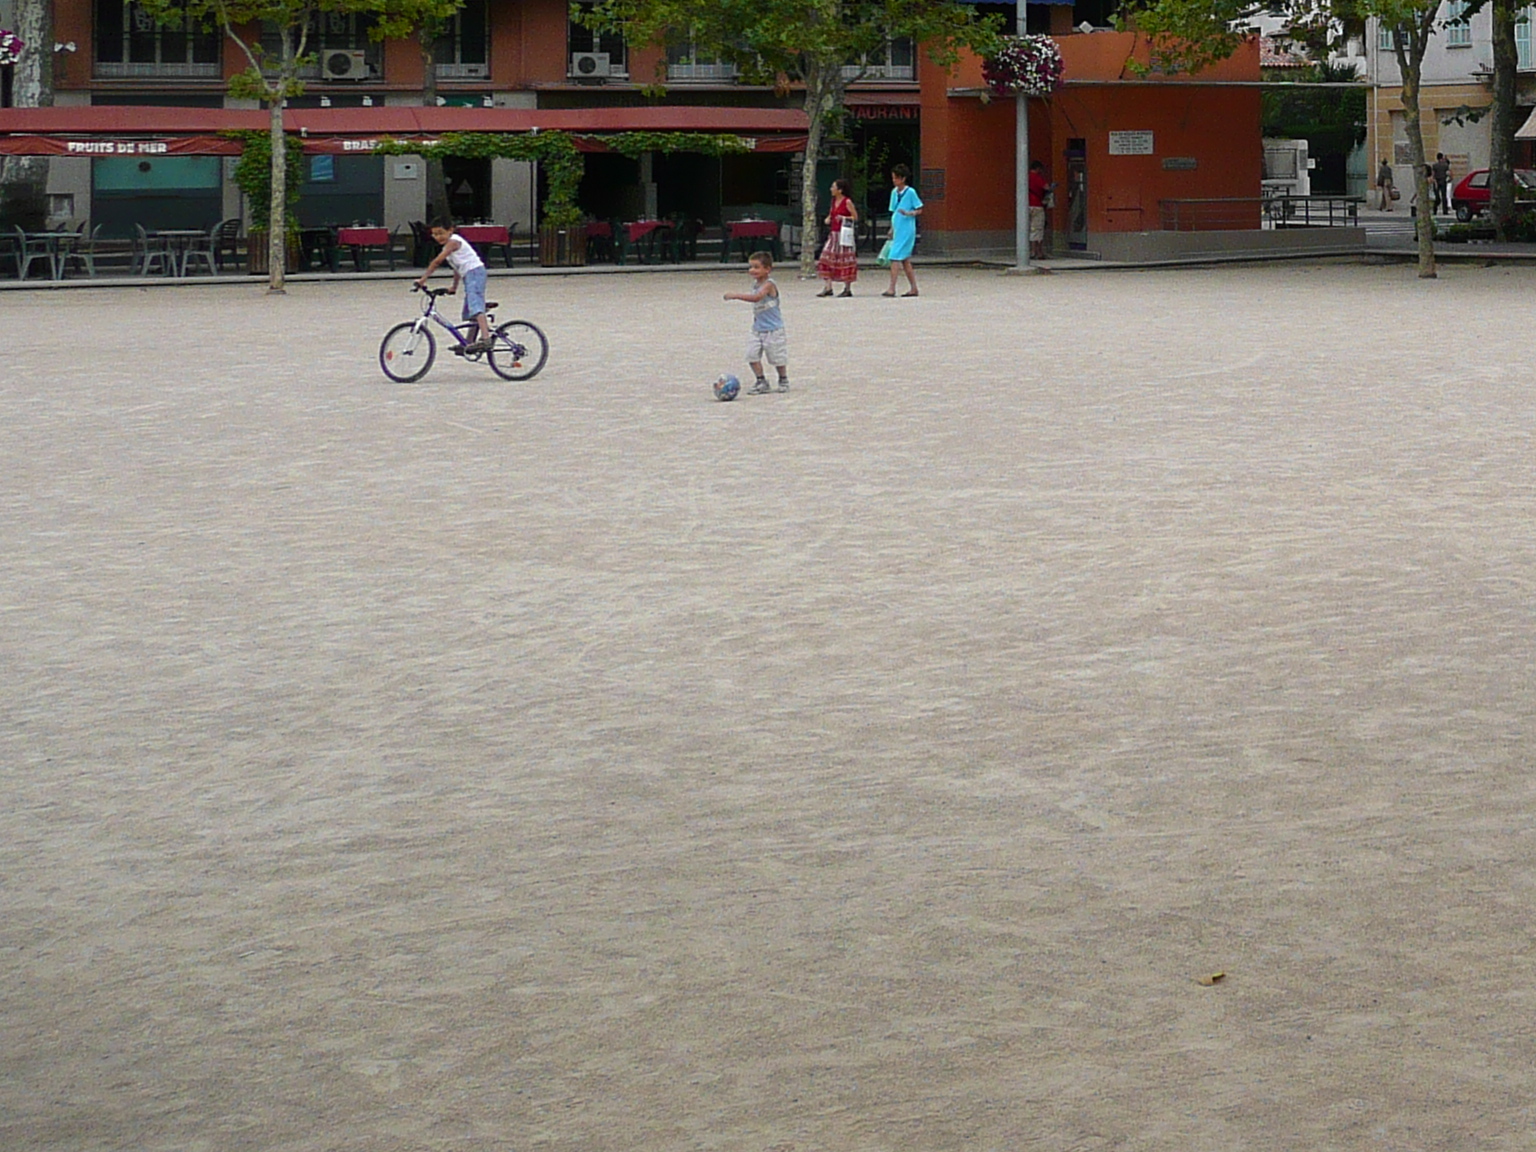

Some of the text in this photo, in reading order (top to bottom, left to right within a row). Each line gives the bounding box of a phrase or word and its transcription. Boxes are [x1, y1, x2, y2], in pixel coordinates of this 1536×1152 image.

[847, 105, 920, 120] TAURANT
[67, 141, 115, 153] FRUITS
[138, 142, 168, 153] MER
